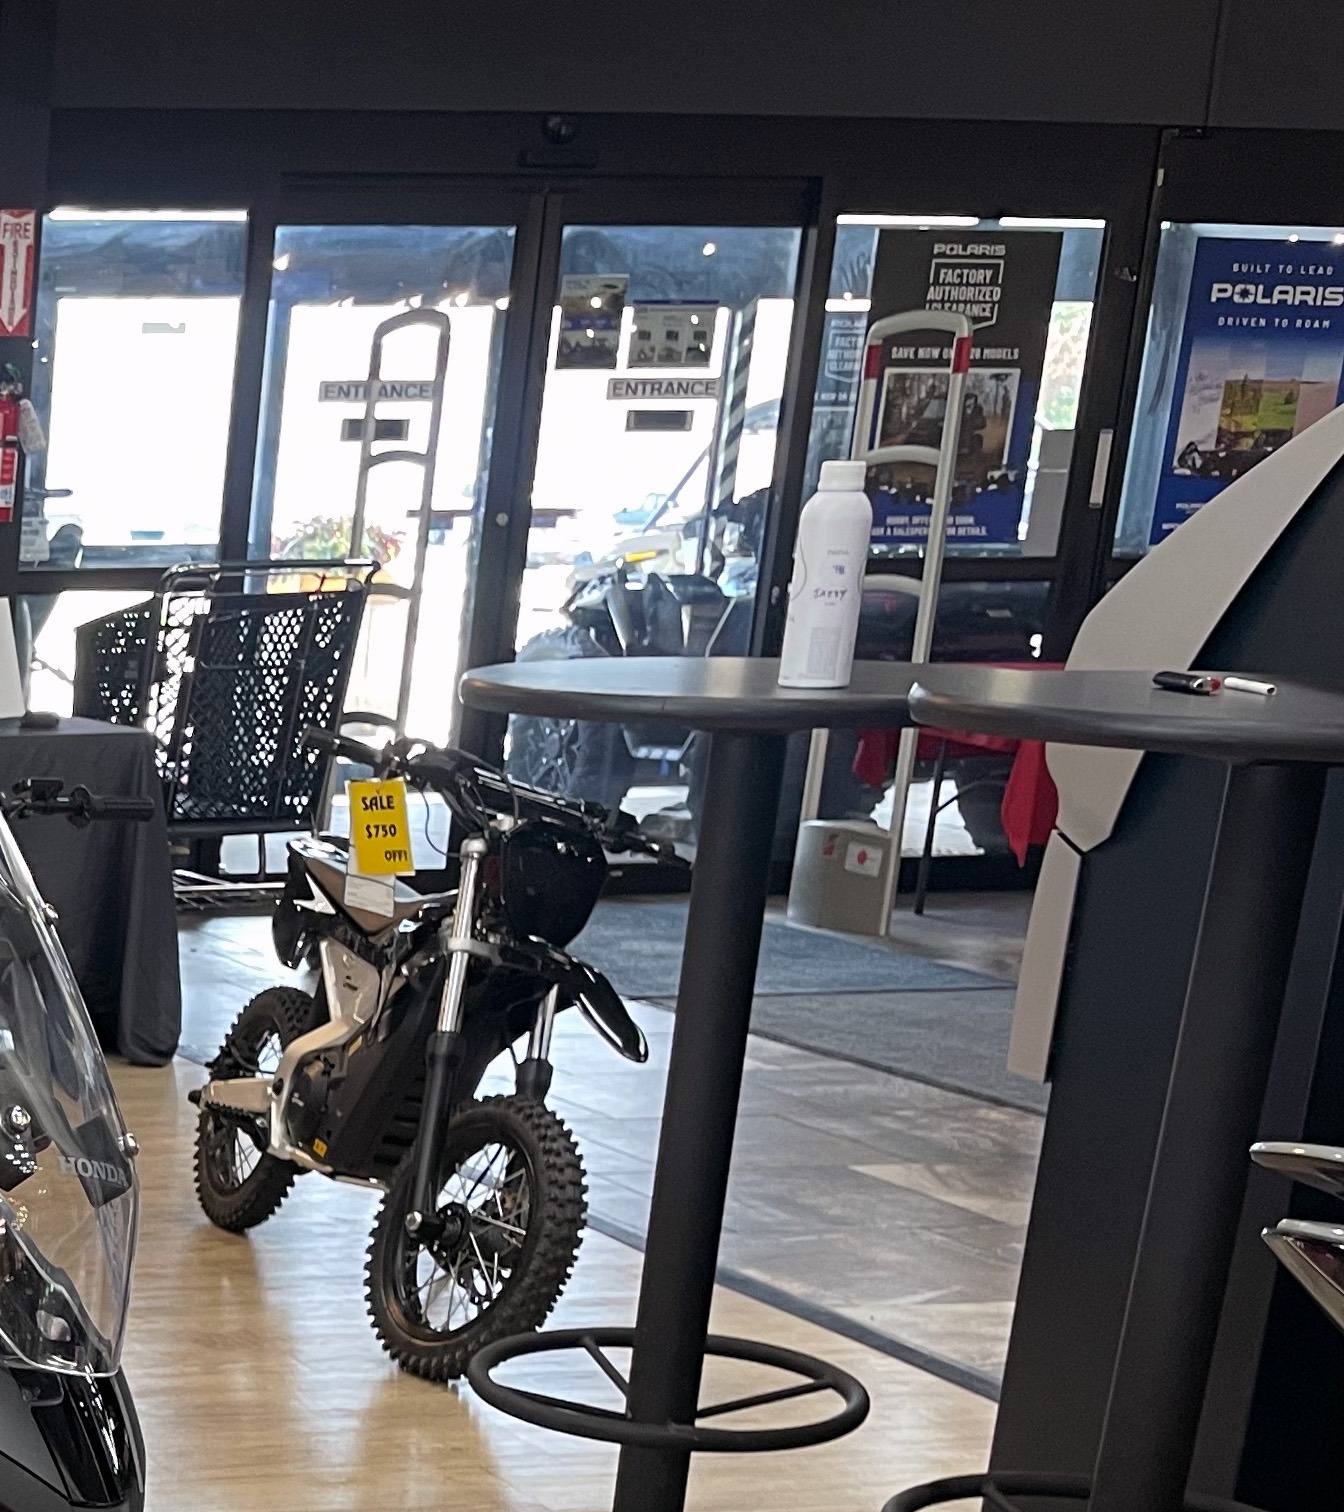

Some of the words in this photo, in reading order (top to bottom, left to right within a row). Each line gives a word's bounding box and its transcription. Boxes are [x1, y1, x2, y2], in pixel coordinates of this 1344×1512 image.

[2, 222, 32, 240] FIRE
[933, 243, 1006, 256] POLARIS
[939, 268, 993, 284] FACTORY
[1232, 263, 1272, 275] BUILT
[1278, 264, 1294, 275] TO
[1300, 265, 1334, 276] LEAD
[926, 286, 1002, 301] AUTHORIZED
[1210, 283, 1344, 307] POLARIS
[1217, 316, 1267, 328] DRIVEN
[1274, 317, 1289, 328] TO
[1295, 318, 1331, 330] ROAM
[891, 346, 915, 360] SAVE
[917, 346, 941, 360] NOW
[982, 347, 1019, 361] MODELS
[324, 382, 432, 400] ENTANCE
[612, 380, 719, 398] ENTRANCE
[361, 795, 395, 812] SALE
[365, 823, 397, 839] $750
[57, 1155, 130, 1190] HONDA
